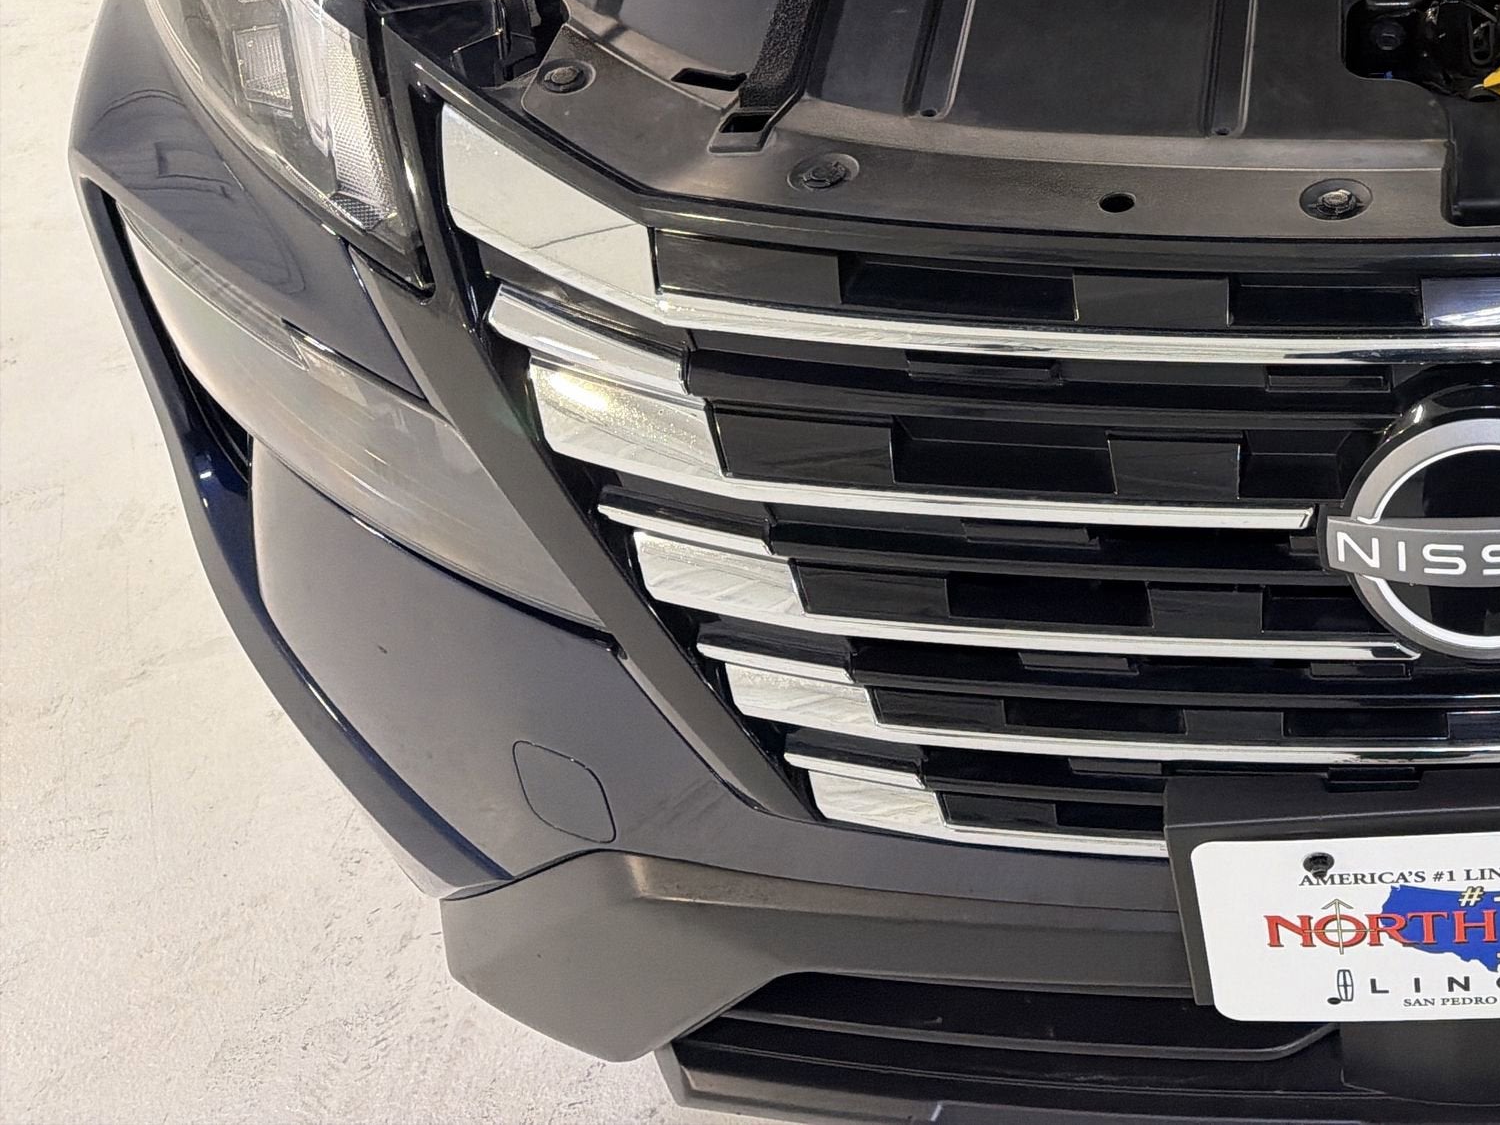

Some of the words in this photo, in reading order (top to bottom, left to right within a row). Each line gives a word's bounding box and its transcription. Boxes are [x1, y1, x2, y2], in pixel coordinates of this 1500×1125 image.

[1299, 870, 1427, 887] AMERICA'S
[1432, 869, 1457, 883] #1
[1263, 909, 1500, 948] NORTH
[1403, 997, 1436, 1008] SAN
[1440, 995, 1499, 1007] PEDRO
